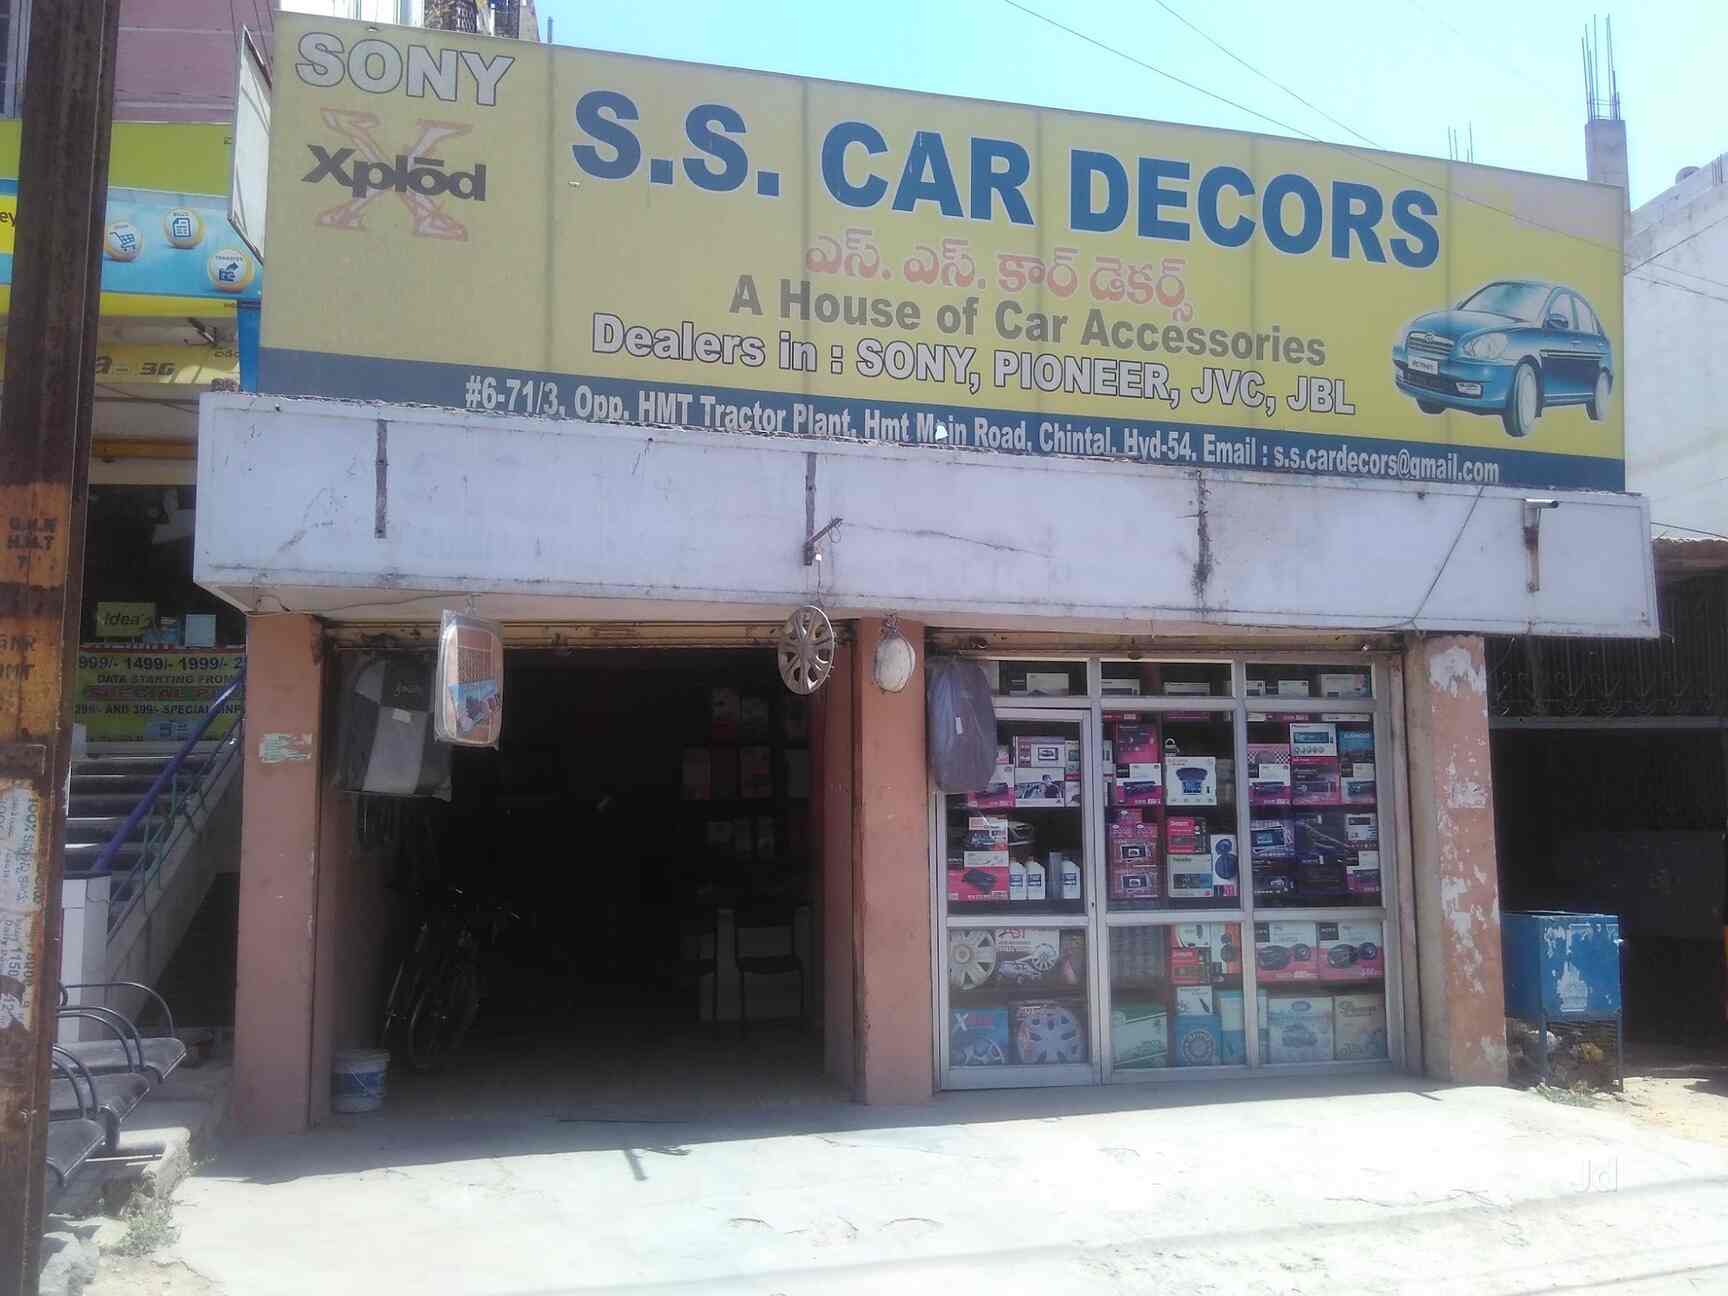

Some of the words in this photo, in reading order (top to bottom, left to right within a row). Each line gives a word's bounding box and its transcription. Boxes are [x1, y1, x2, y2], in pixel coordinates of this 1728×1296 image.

[295, 31, 516, 107] SONY
[572, 89, 780, 197] S.S.
[820, 120, 1036, 226] CAR
[1069, 147, 1442, 270] DECORS
[592, 312, 766, 368] Dealers
[778, 330, 818, 373] in
[856, 337, 981, 395] SONY,
[993, 349, 1180, 409] PIONEER,
[1190, 366, 1276, 417] JVC,
[1286, 374, 1357, 416] JBL
[728, 274, 764, 316] A
[779, 277, 921, 331] House
[935, 296, 980, 336] of
[993, 299, 1068, 344] Car
[1080, 307, 1328, 367] Accessories
[574, 384, 631, 420] Opp.
[638, 390, 693, 426] HMT
[700, 395, 787, 433] Tractor
[864, 408, 911, 441] Hmt
[974, 416, 1033, 453] Road,
[1203, 432, 1257, 465] Email
[1273, 443, 1500, 482] s.s.cardecors@gmail.com
